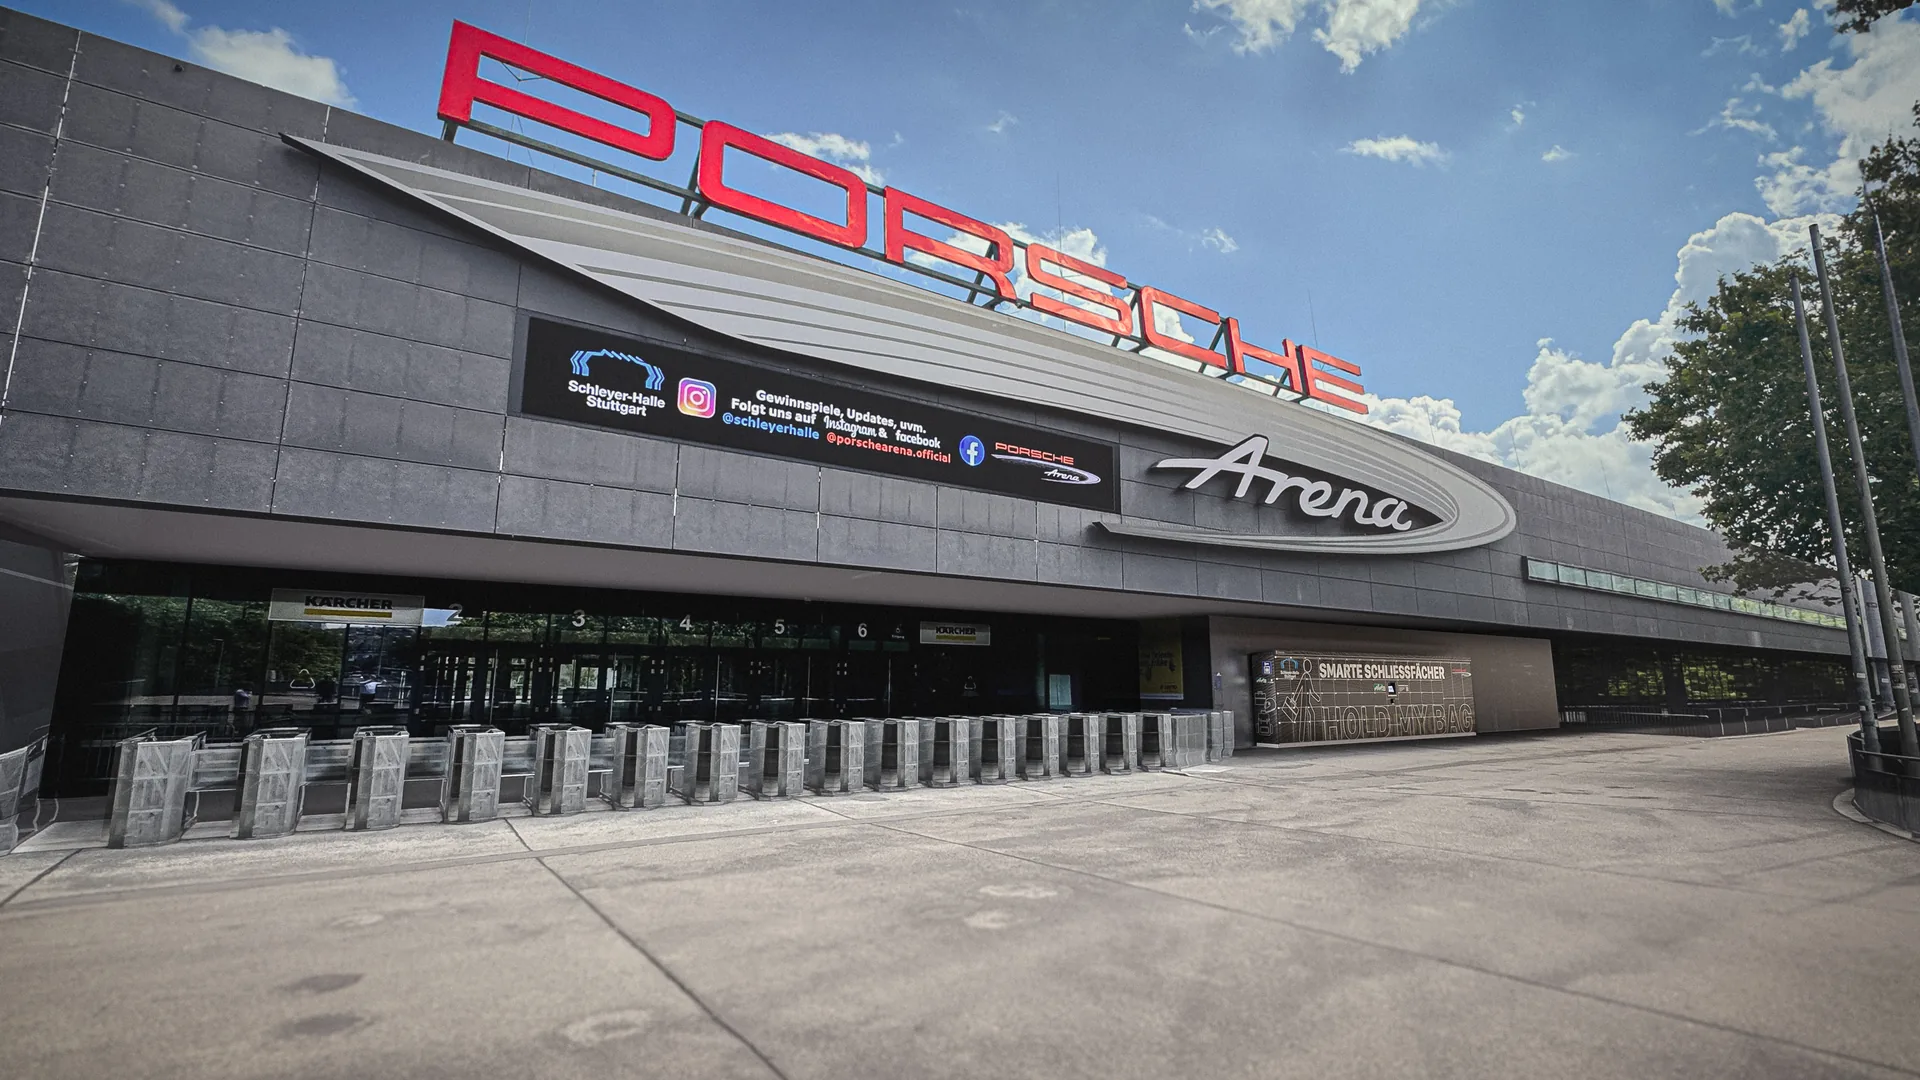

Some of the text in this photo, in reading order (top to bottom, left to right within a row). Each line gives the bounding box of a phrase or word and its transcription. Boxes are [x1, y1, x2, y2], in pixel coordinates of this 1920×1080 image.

[437, 18, 1368, 415] PORSCHE
[567, 379, 665, 409] Schleyer-Halle
[586, 394, 647, 417] Stuttgart
[731, 397, 941, 449] Folgt uns auf Instagram & facebook
[755, 389, 927, 434] Gewinnspiele, Updates, uvm.
[722, 411, 951, 464] @schleyerhalle @porschearena.official
[995, 442, 1075, 466] PORSCHE
[1043, 468, 1080, 482] Arena
[1156, 434, 1413, 531] Arena
[446, 603, 464, 622] 2
[571, 609, 586, 628] 3
[679, 614, 692, 631] 4
[774, 619, 786, 635] 5
[857, 623, 868, 639] 6
[1319, 663, 1363, 679] SMARTE
[1364, 663, 1446, 680] SCHLIESSFÄCHER
[1321, 703, 1474, 741] HOLD MY BAG
